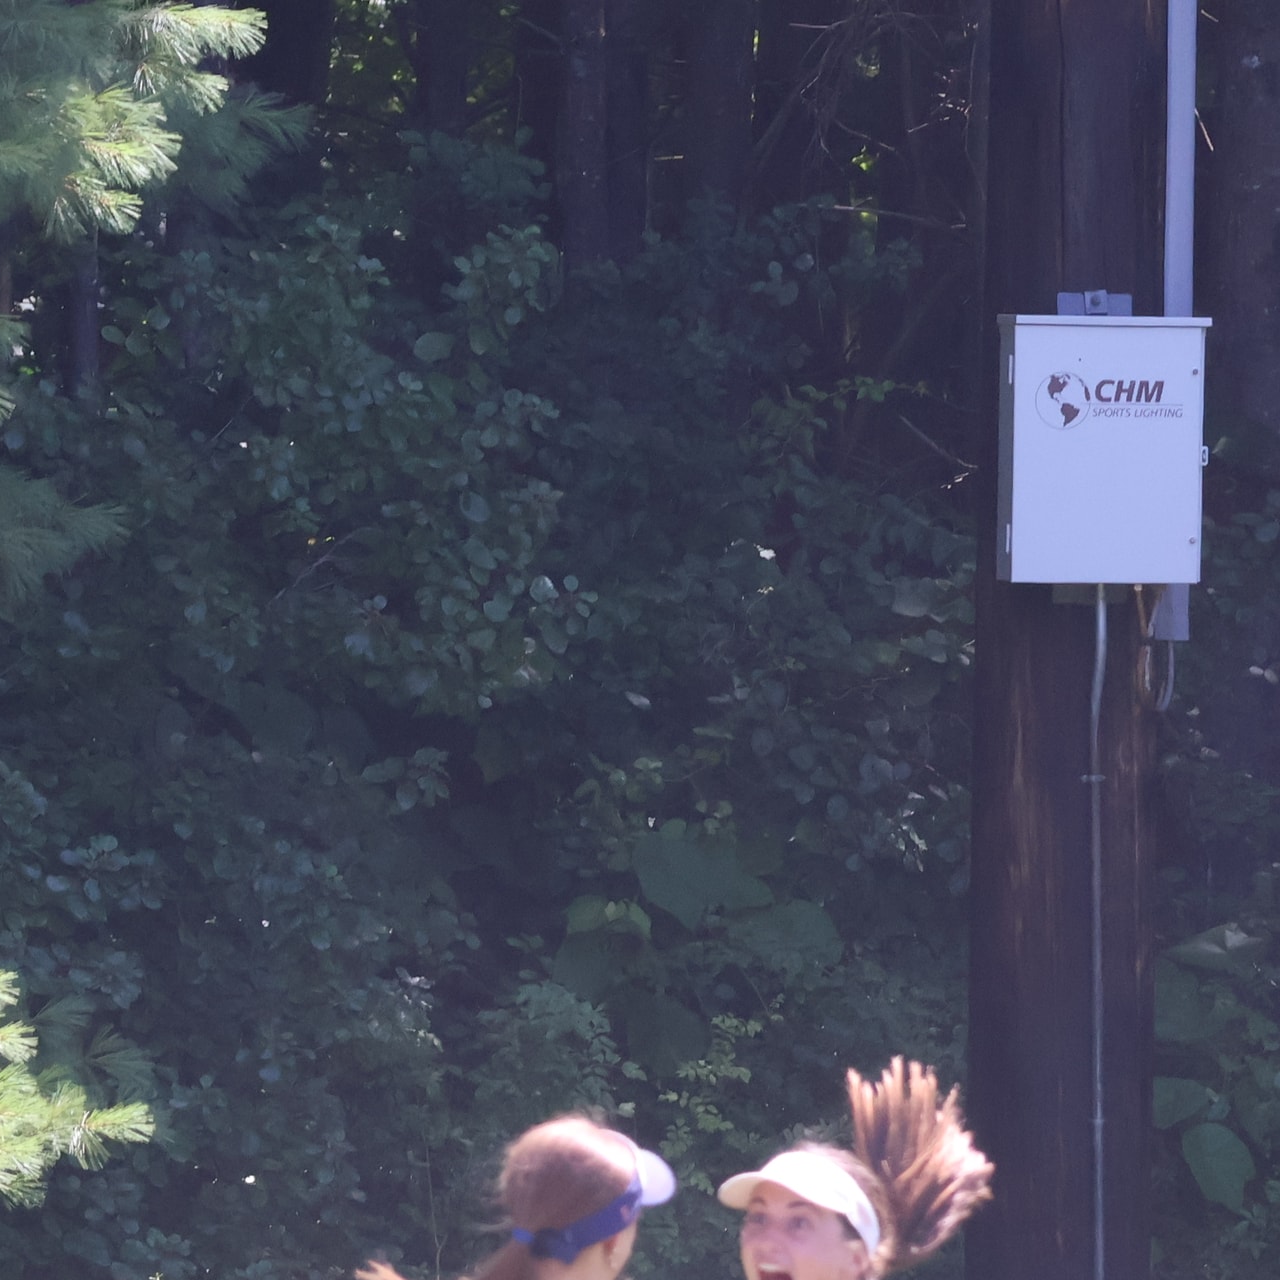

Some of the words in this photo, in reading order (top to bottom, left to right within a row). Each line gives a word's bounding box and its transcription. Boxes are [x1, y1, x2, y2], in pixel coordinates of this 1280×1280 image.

[1095, 379, 1164, 403] CHM
[1092, 407, 1131, 417] SPORTS
[1134, 407, 1184, 419] LIGHTING
